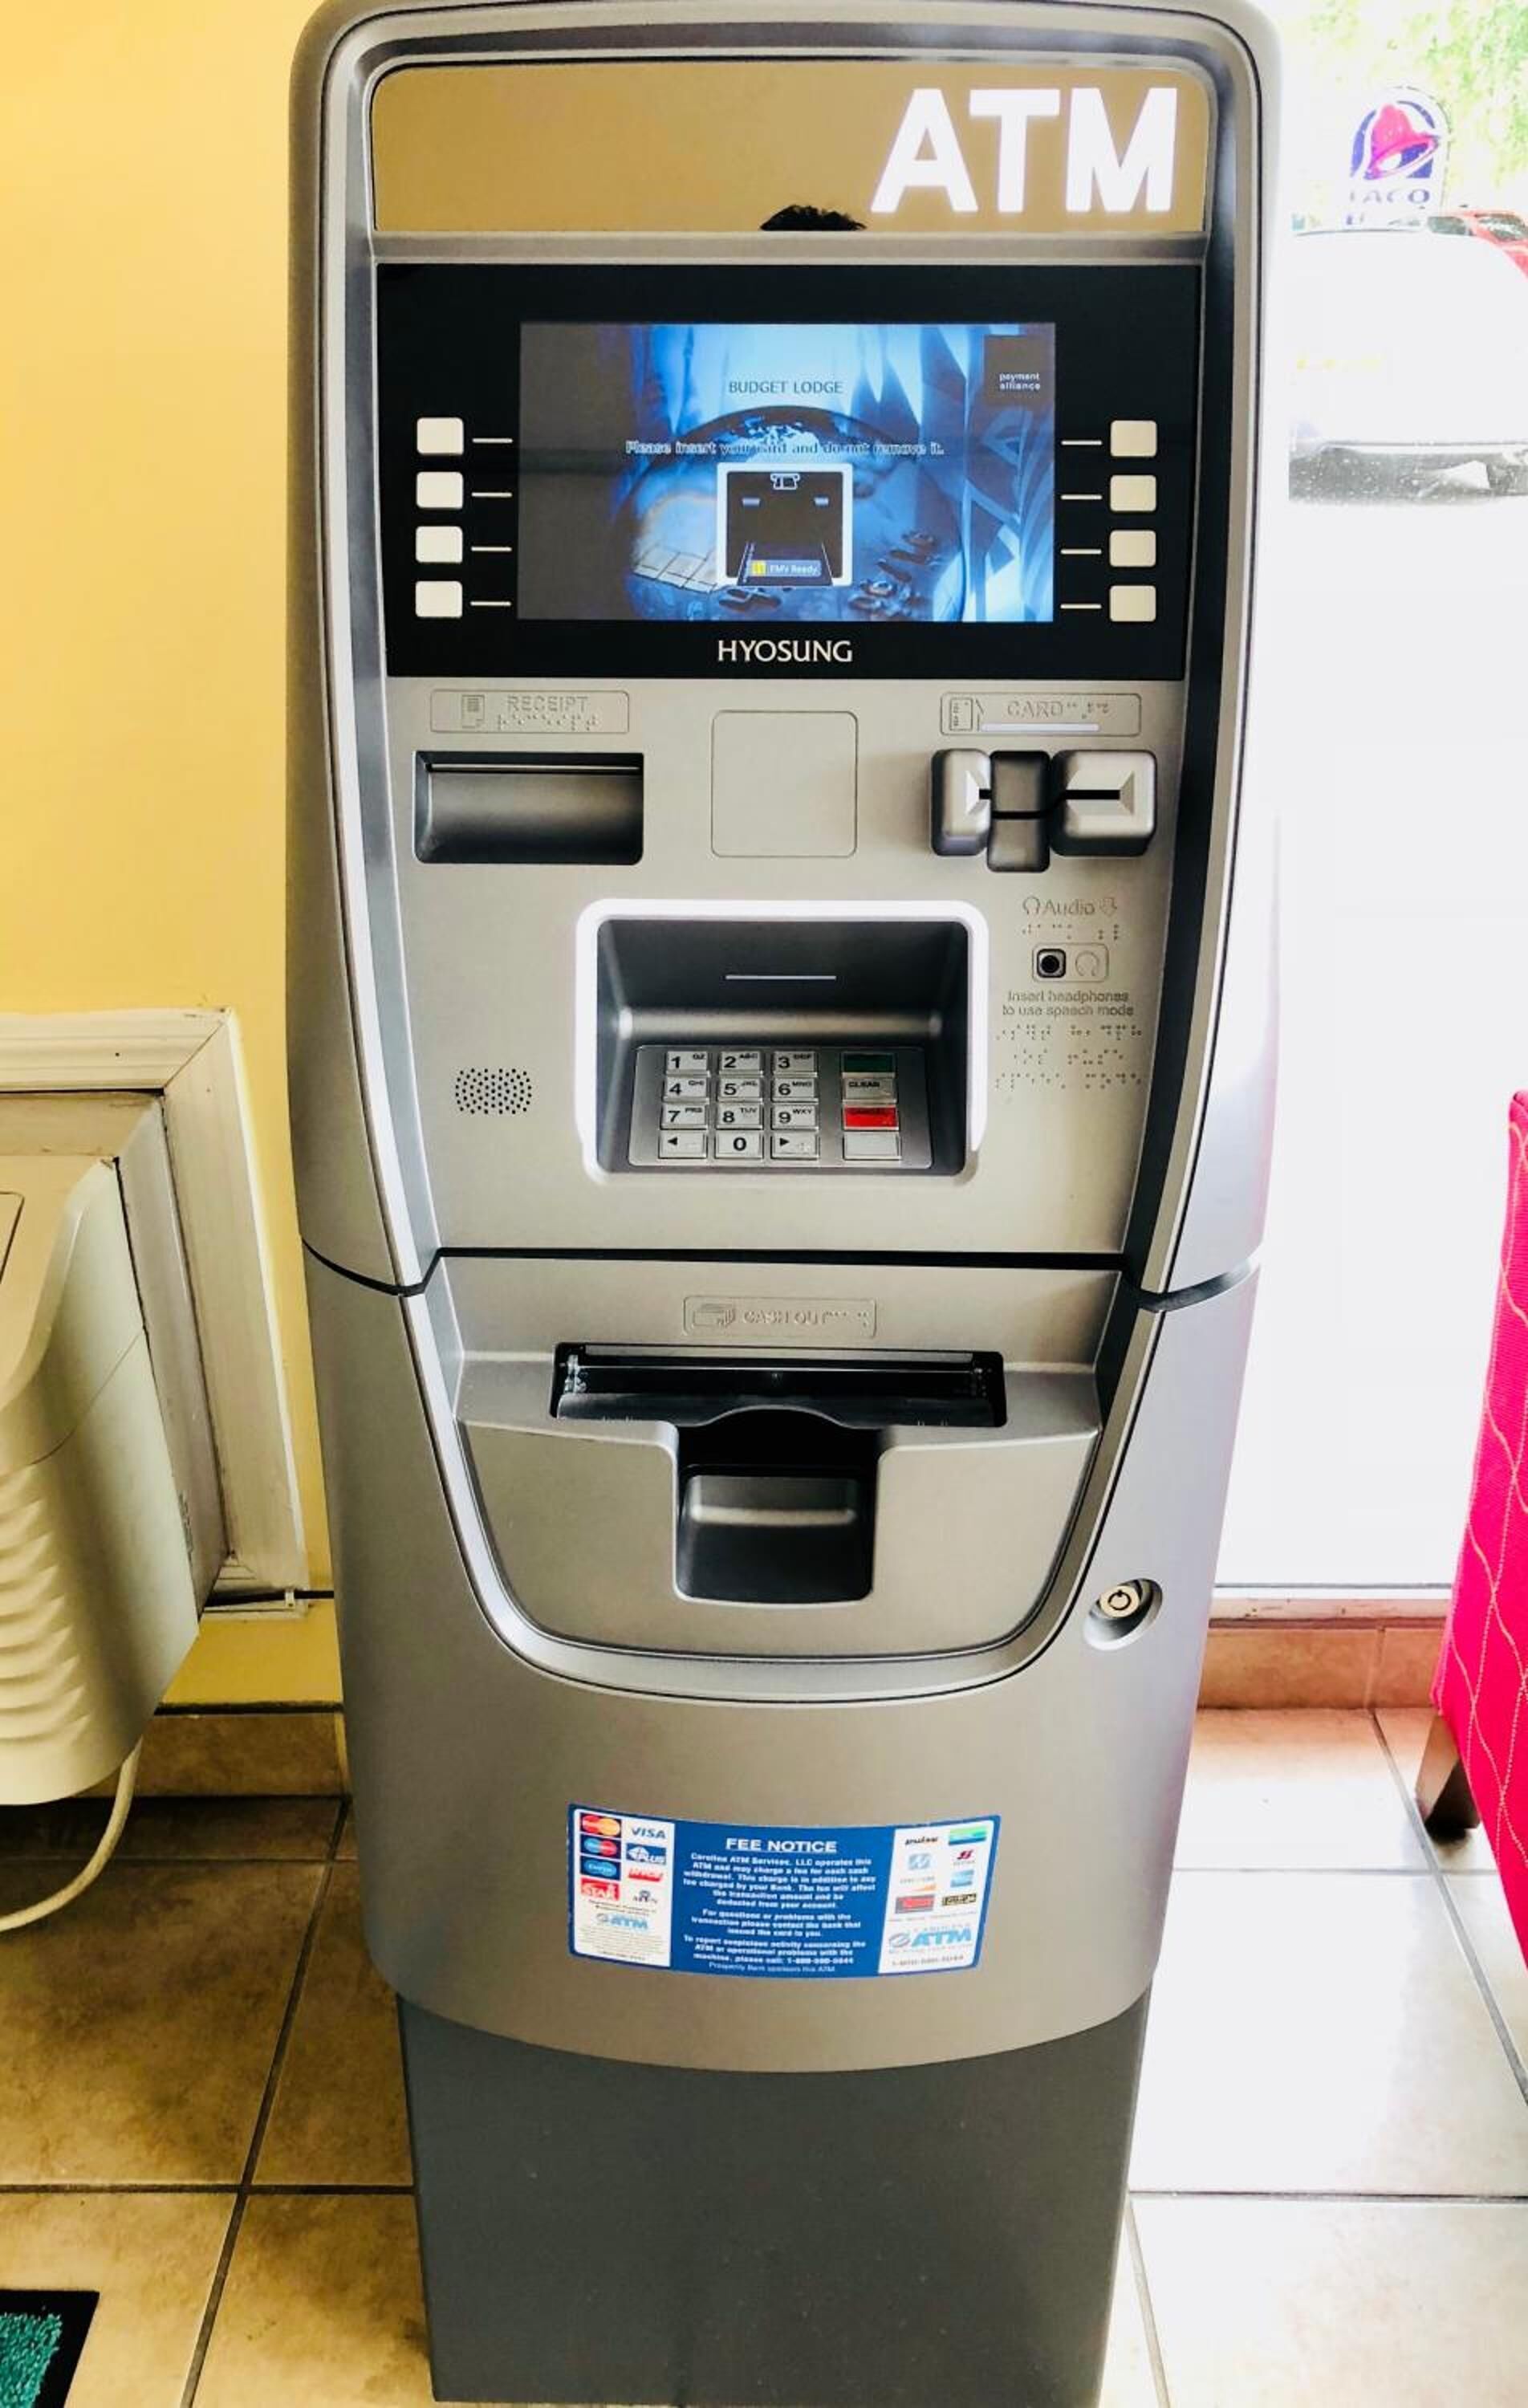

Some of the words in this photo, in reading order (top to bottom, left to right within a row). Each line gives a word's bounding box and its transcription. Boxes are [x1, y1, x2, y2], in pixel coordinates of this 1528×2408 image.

[870, 87, 1178, 214] ATM
[999, 372, 1040, 384] payment
[729, 381, 786, 394] BUDGET
[793, 381, 844, 394] LODGE
[1000, 382, 1041, 392] alliance
[626, 441, 671, 454] Please
[676, 440, 717, 454] insert
[720, 443, 754, 458] your
[792, 441, 818, 454] and
[823, 441, 839, 454] do
[873, 443, 926, 455] remove
[931, 441, 945, 455] it.
[718, 640, 854, 662] HYOSUNG
[507, 695, 591, 714] RECEIPT
[1006, 701, 1065, 718] CARD
[1045, 899, 1095, 916] Audio
[1009, 990, 1045, 1003] Insert
[1048, 990, 1129, 1006] headphones
[1003, 1004, 1015, 1016] to
[1018, 1007, 1042, 1016] use
[1046, 1004, 1094, 1019] speech
[1097, 1003, 1135, 1016] mode
[671, 1056, 681, 1070] 1
[724, 1056, 738, 1069] 2
[778, 1056, 791, 1070] 3
[669, 1083, 682, 1096] 4
[724, 1083, 738, 1096] 5
[778, 1083, 792, 1096] 6
[668, 1109, 681, 1123] 7
[722, 1110, 736, 1124] 8
[778, 1111, 792, 1125] 9
[733, 1137, 748, 1151] 0
[743, 1309, 789, 1324] CASH
[793, 1309, 827, 1325] OUT
[632, 1827, 666, 1840] VISA
[725, 1837, 762, 1851] FEE
[767, 1840, 837, 1853] NOTICE
[691, 1853, 728, 1864] Carolina
[729, 1856, 749, 1864] ATM
[795, 1858, 813, 1866] LLC
[815, 1858, 853, 1868] operates
[855, 1857, 872, 1866] this
[693, 1861, 712, 1871] ATM
[733, 1865, 752, 1874] may
[754, 1865, 784, 1875] charge
[699, 1879, 734, 1890] charged
[738, 1873, 756, 1882] This
[758, 1874, 788, 1885] charge
[582, 1883, 617, 1899] STAR
[702, 1909, 717, 1918] For
[695, 1935, 721, 1946] report
[911, 1927, 973, 1948] ATM
[694, 1943, 714, 1952] ATM
